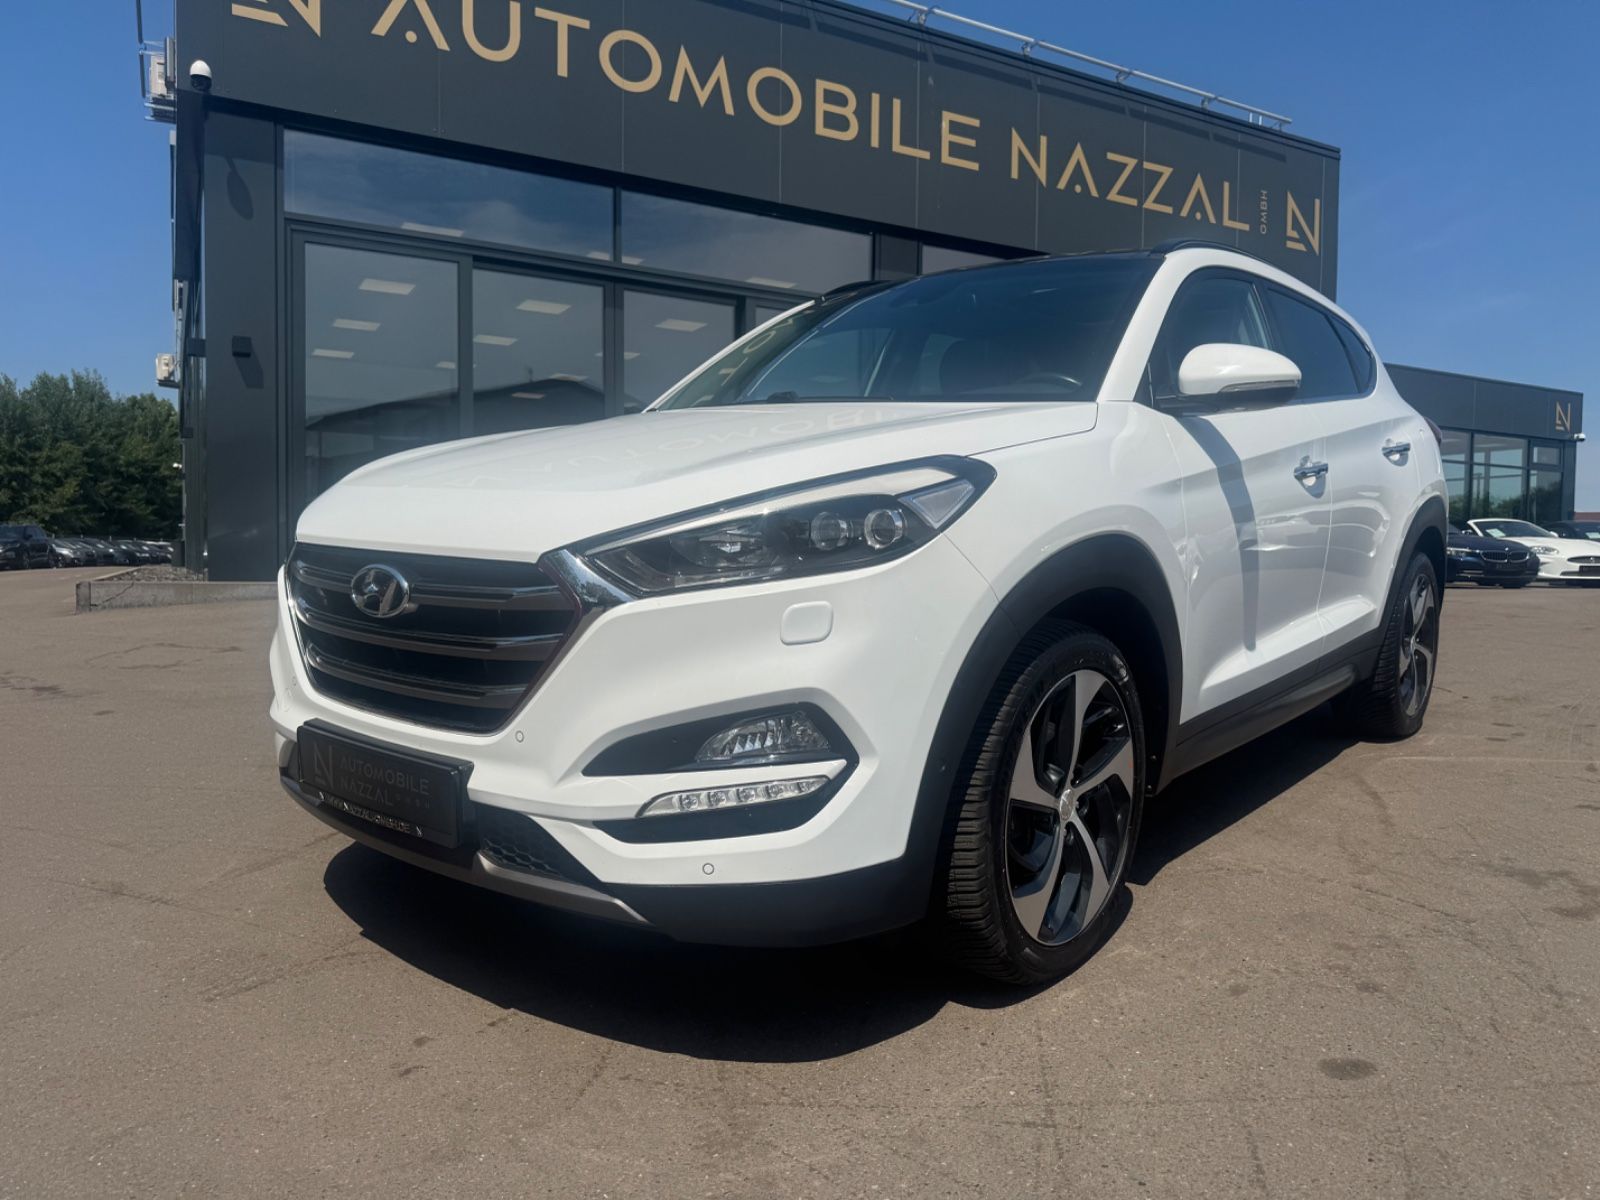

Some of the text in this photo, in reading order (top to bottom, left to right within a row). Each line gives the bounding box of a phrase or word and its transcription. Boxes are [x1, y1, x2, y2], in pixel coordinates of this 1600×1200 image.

[371, 0, 1250, 231] AUTOMOBILE NAZZAL
[337, 776, 395, 807] NAZZAL
[339, 754, 431, 796] AUTOMOBILE
